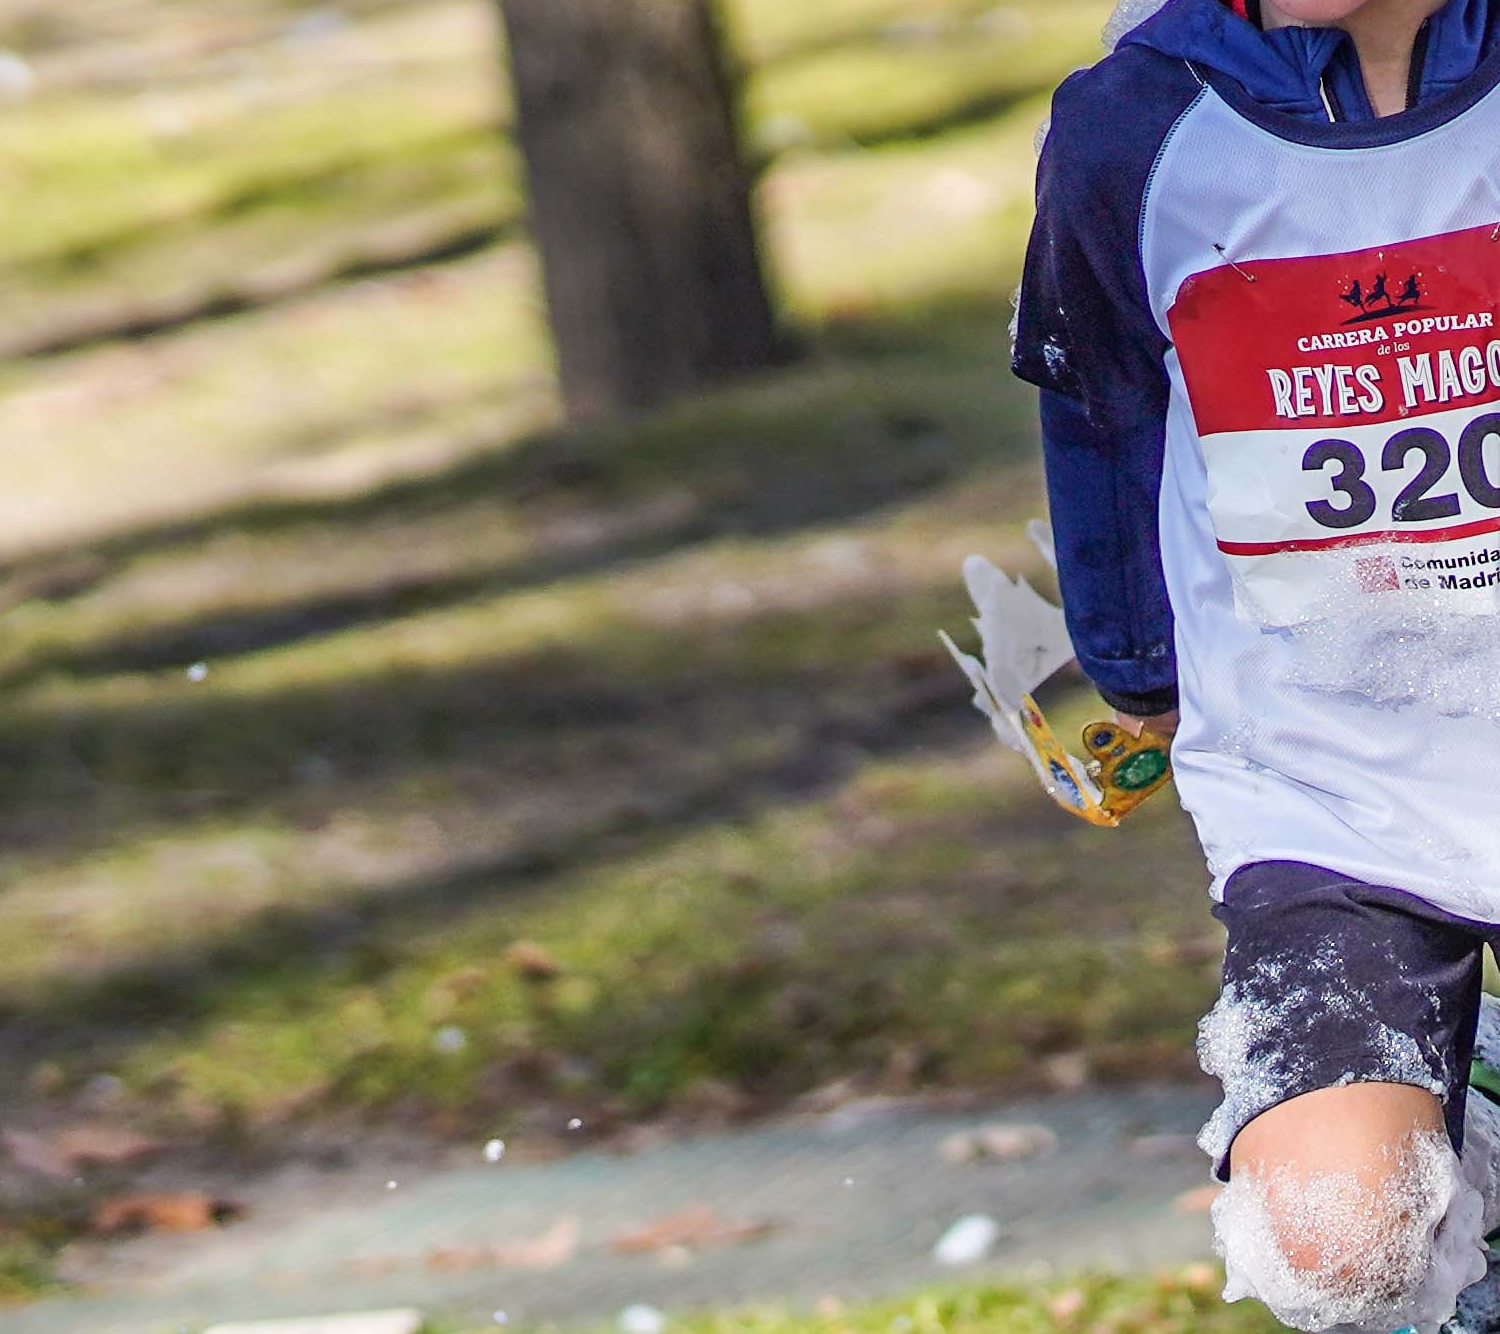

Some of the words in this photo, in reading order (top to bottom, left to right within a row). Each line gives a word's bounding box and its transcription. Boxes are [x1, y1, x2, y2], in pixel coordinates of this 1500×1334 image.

[1297, 326, 1388, 352] CARRERA
[1394, 312, 1494, 338] POPULAR
[1377, 345, 1391, 356] de
[1393, 341, 1411, 354] los
[1266, 364, 1385, 419] REYES
